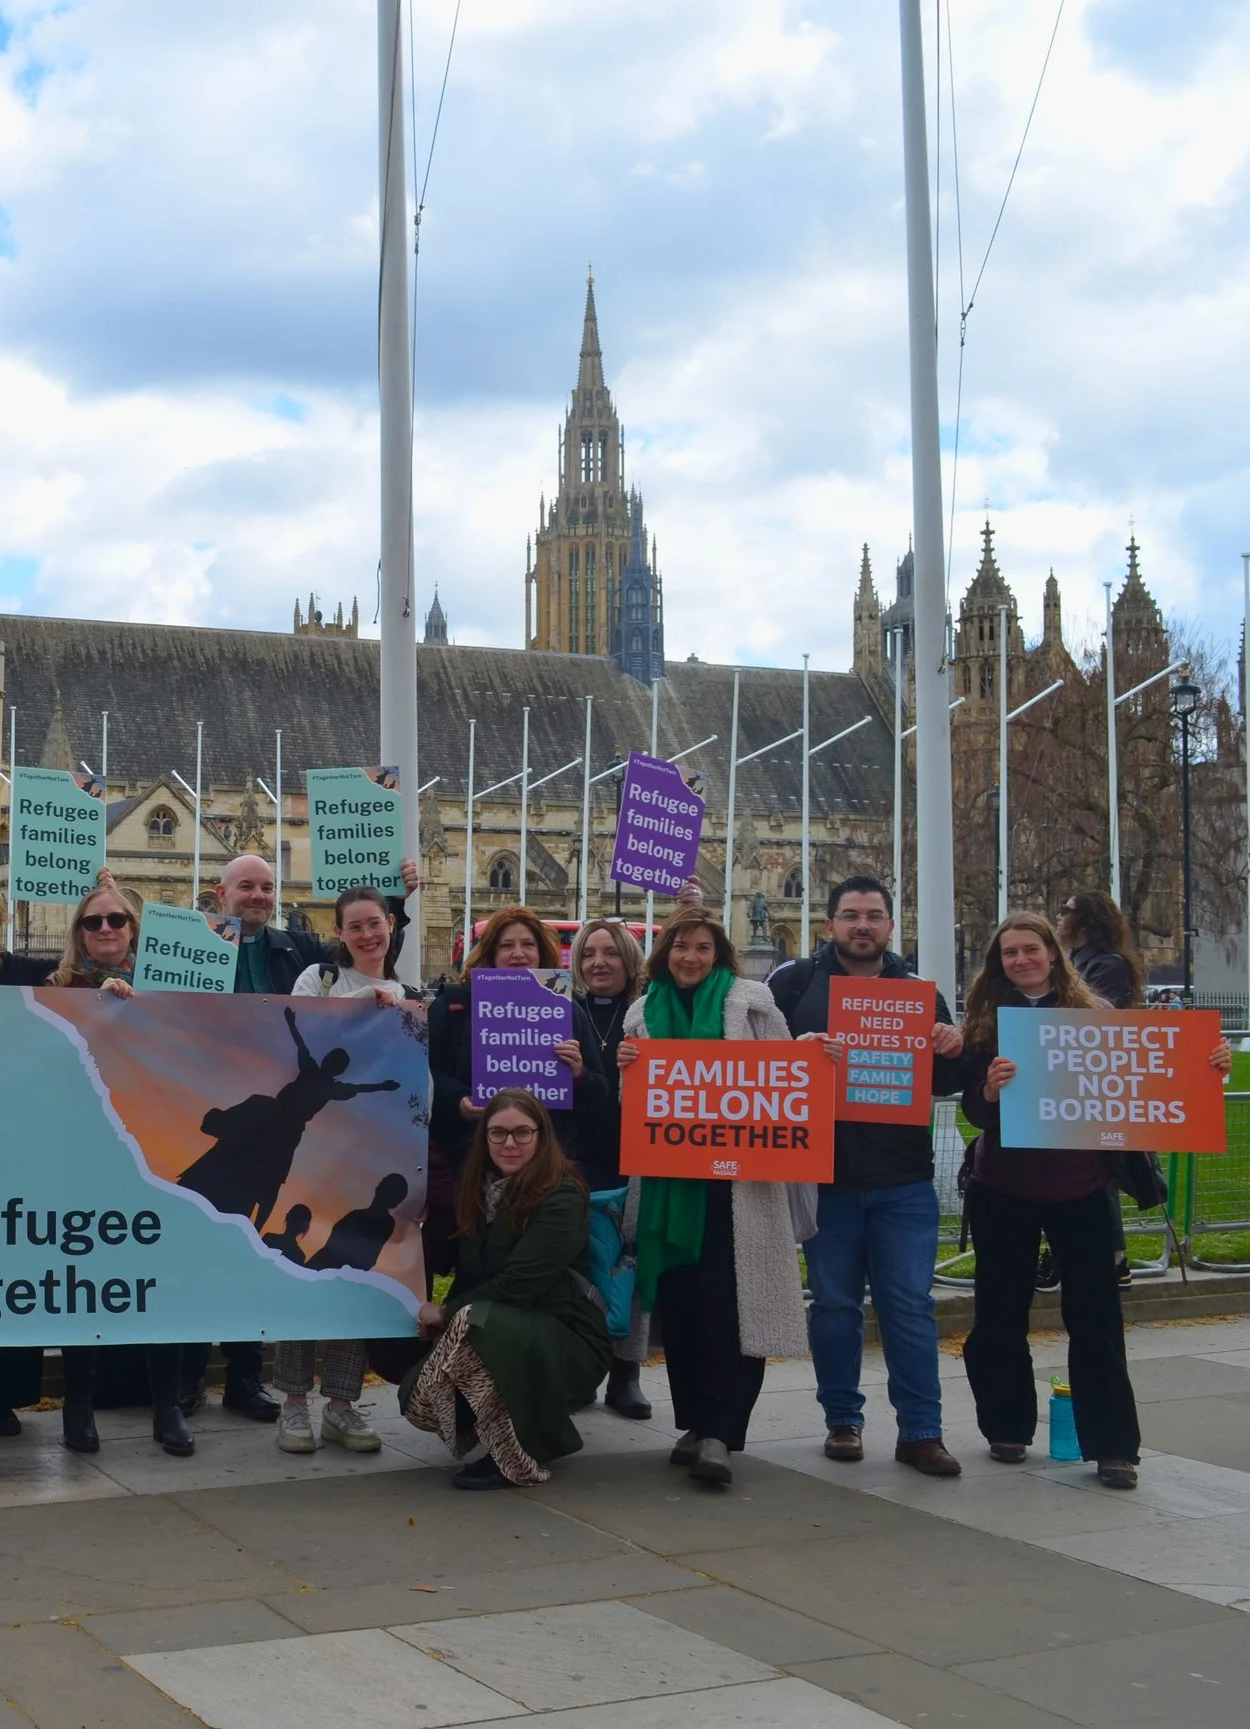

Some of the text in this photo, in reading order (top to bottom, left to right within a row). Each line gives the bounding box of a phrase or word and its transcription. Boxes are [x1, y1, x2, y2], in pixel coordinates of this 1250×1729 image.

[19, 798, 99, 822] Refugee
[314, 799, 395, 817] Refugee
[629, 783, 699, 817] Refugee
[20, 824, 97, 846] families
[317, 823, 395, 840] families
[627, 809, 694, 841] families
[324, 848, 390, 866] belong
[627, 834, 686, 867] belong
[25, 850, 91, 875] belong
[15, 876, 96, 897] togethe
[145, 936, 230, 965] Refugee
[143, 964, 225, 992] families
[478, 1001, 565, 1022] Refugee
[842, 998, 924, 1014] REFUGEES
[860, 1016, 904, 1030] NEED
[480, 1028, 563, 1046] families
[836, 1032, 927, 1049] ROUTES TO
[1039, 1025, 1180, 1049] PROTECT
[486, 1055, 558, 1077] belong
[850, 1051, 912, 1065] SAFETY
[1047, 1049, 1174, 1078] PEOPLE,
[648, 1059, 810, 1088] FAMILIES
[849, 1070, 911, 1086] FAMILY
[477, 1083, 568, 1101] tother
[855, 1089, 900, 1104] HOPE
[1078, 1074, 1144, 1097] NOT
[646, 1088, 809, 1122] BELONG
[1038, 1098, 1186, 1124] BORDERS
[644, 1122, 810, 1150] TOGETHER
[1100, 1132, 1124, 1140] SAFE
[713, 1160, 738, 1170] SAFE
